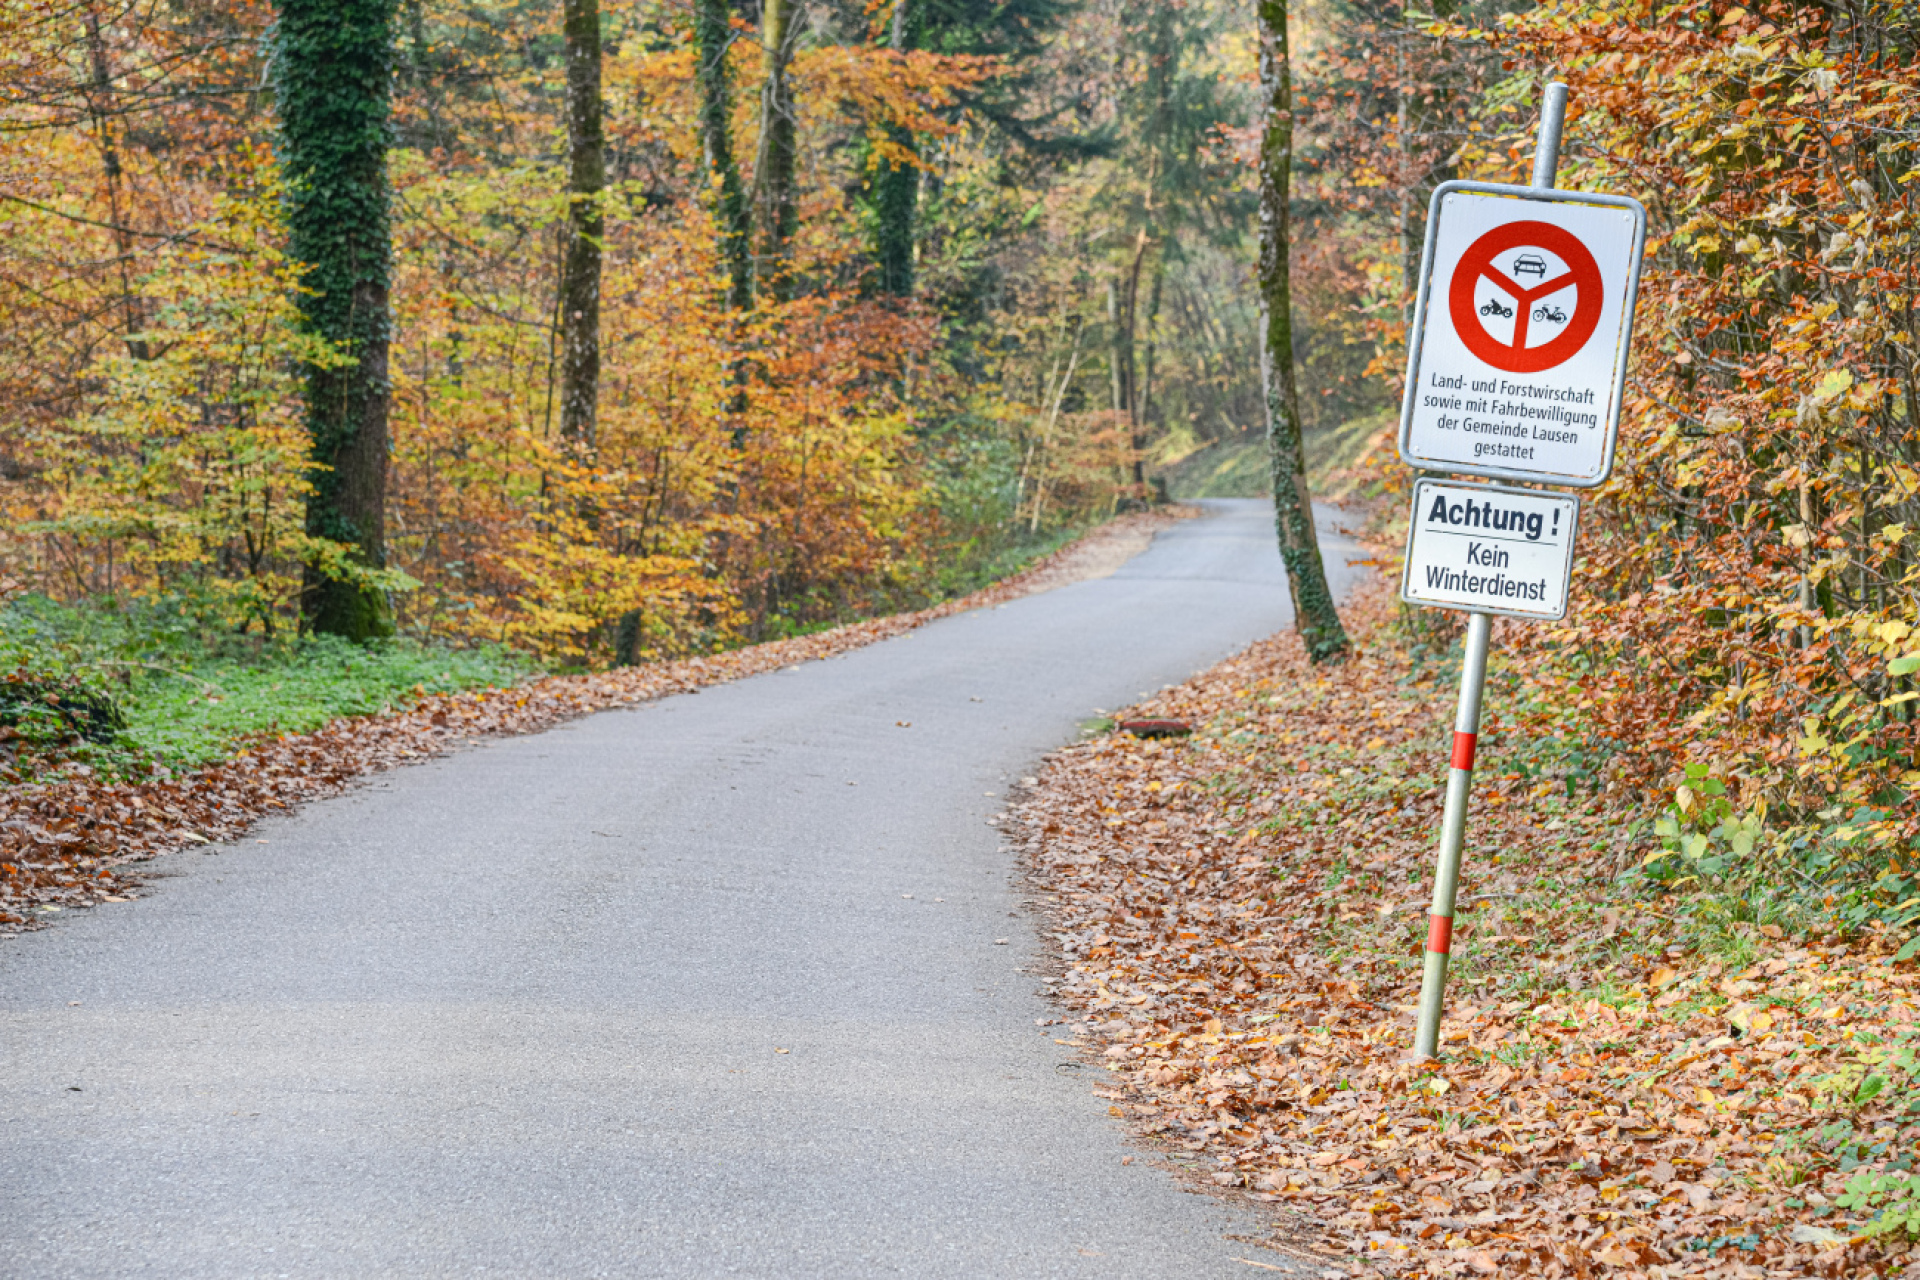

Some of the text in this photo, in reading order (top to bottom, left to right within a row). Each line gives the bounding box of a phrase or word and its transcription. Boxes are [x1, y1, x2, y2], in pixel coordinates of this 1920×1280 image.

[1431, 372, 1595, 405] Land- und Forstwirschaft
[1424, 394, 1598, 430] sowie mit Fahrbewilligung
[1437, 413, 1578, 444] der Gemeinde Lausen
[1474, 441, 1535, 460] gestattet
[1427, 495, 1544, 541] Achtung
[1467, 541, 1509, 568] Kein
[1426, 565, 1547, 601] Winterdienst
